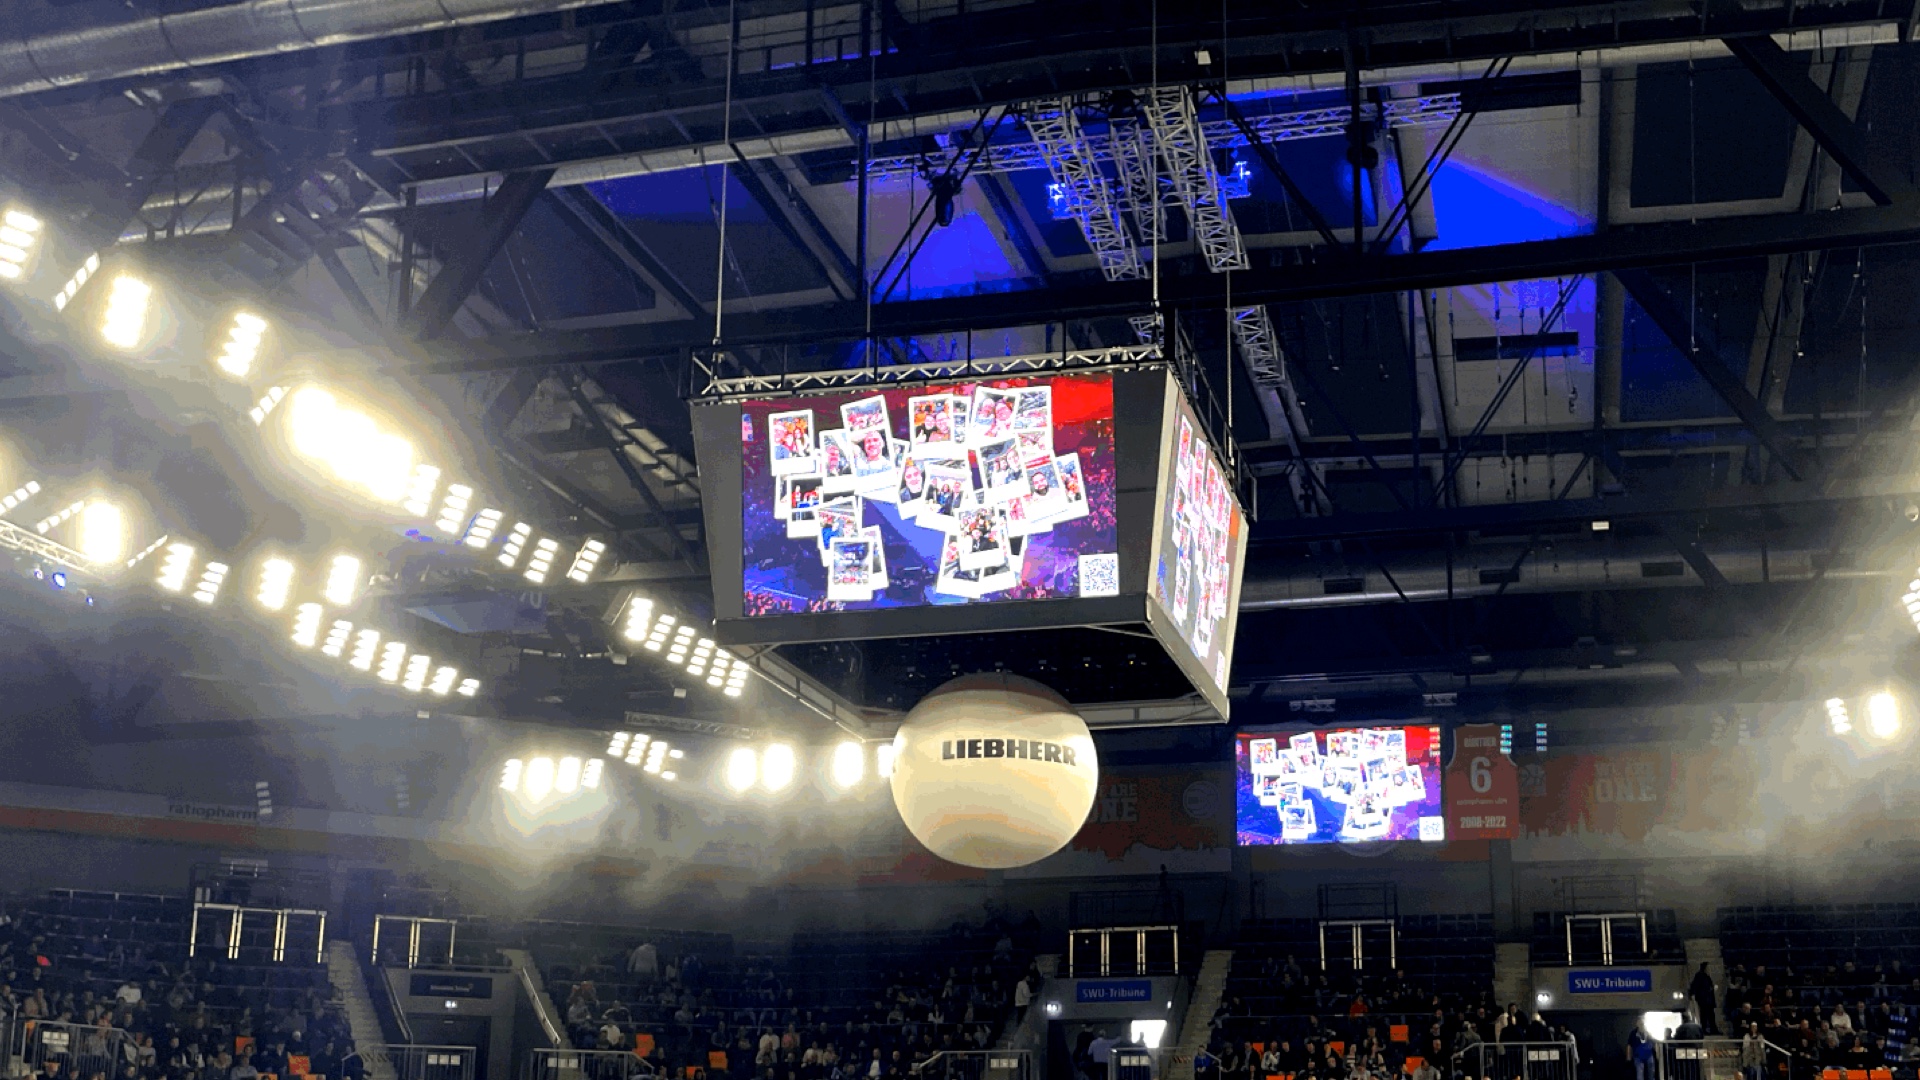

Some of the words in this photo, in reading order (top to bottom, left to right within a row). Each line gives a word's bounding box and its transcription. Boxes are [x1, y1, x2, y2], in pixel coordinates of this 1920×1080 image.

[942, 739, 1077, 767] LIEBHERR
[1470, 756, 1492, 793] 6
[1595, 779, 1657, 802] ONE
[168, 804, 258, 820] ratiopharm
[1082, 987, 1146, 998] SWU-Tribüne
[1574, 977, 1646, 989] SWU-Tribüne
